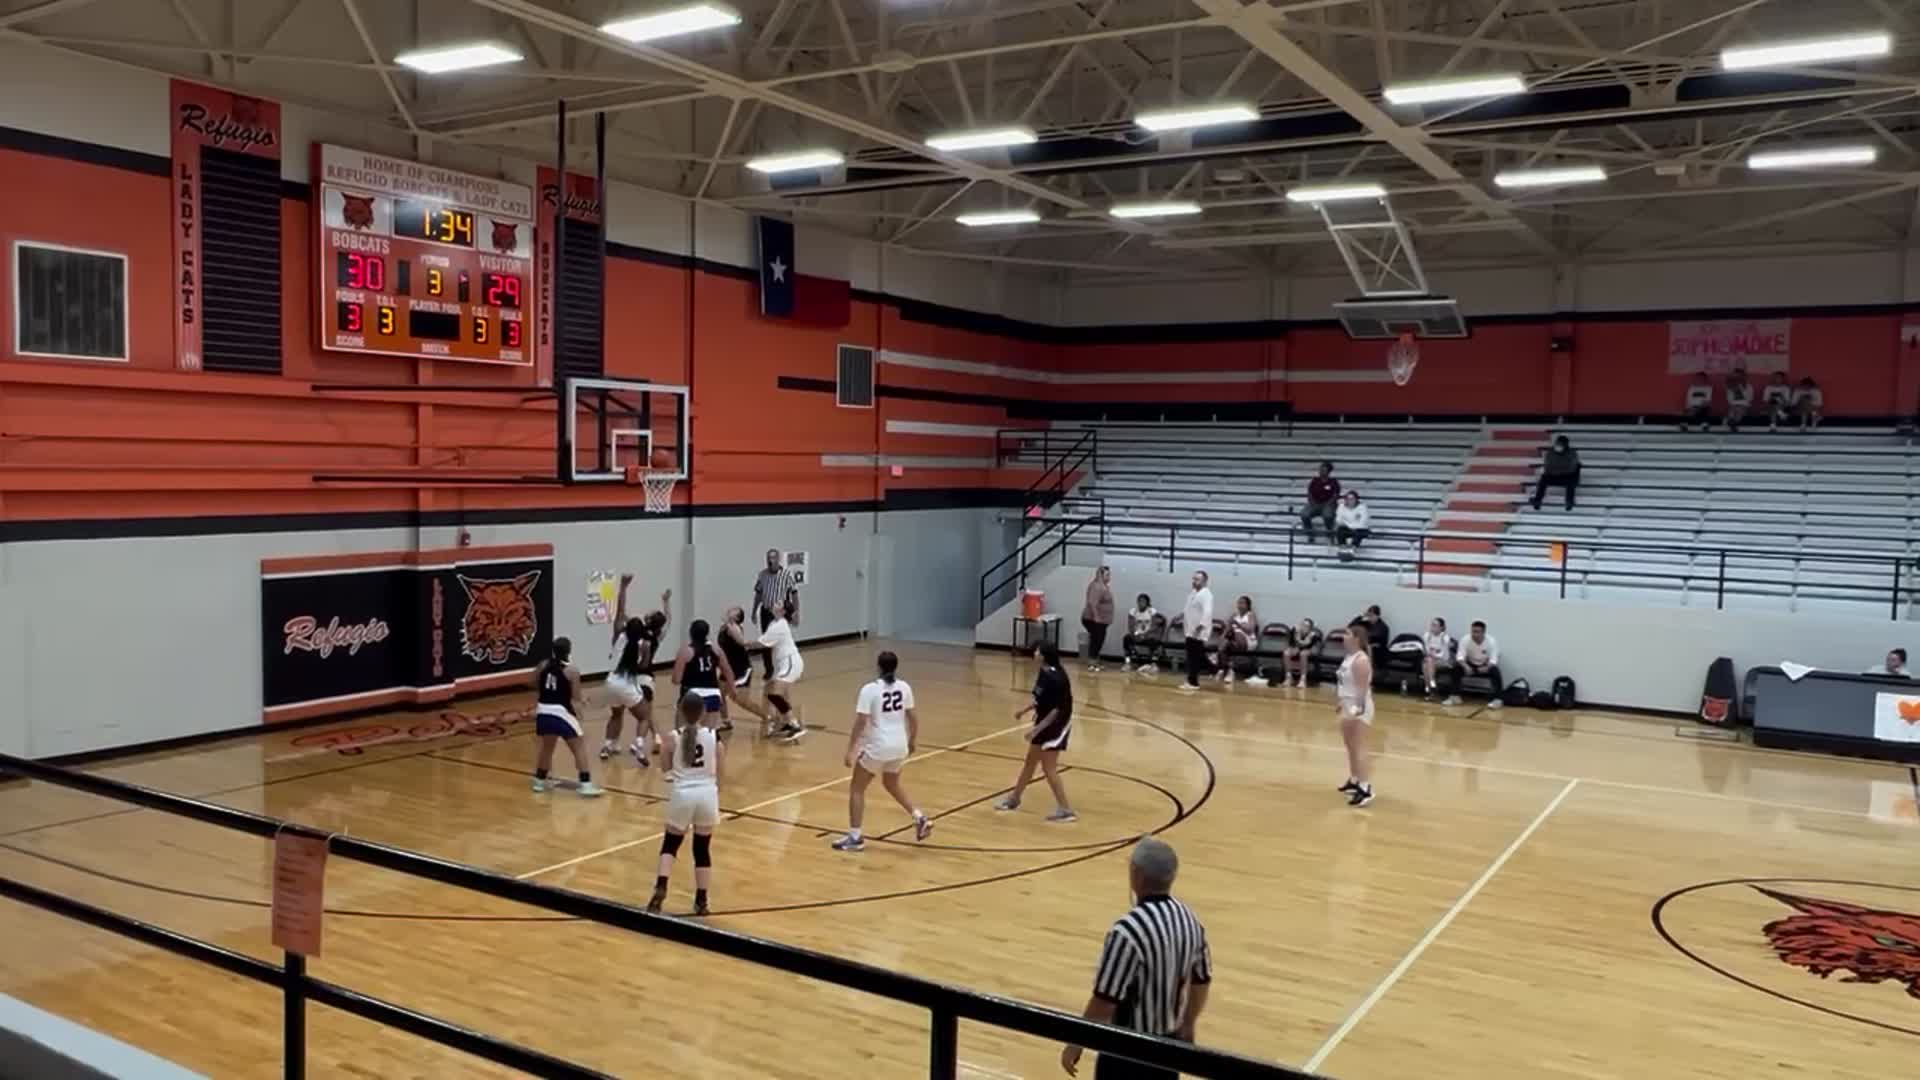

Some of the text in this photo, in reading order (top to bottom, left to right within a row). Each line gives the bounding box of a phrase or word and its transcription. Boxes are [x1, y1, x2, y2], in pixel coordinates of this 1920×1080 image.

[180, 103, 277, 151] Refugio
[327, 164, 388, 188] REFUGIO
[363, 156, 500, 194] HOME OF CHAMPIONS
[422, 207, 472, 243] 1:34
[181, 163, 194, 325] LADY CATS
[332, 231, 391, 255] BOBCATS
[347, 253, 384, 291] 30
[479, 254, 522, 273] VISITOR
[428, 269, 441, 295] 3
[487, 275, 520, 307] 29
[347, 304, 361, 331] 3
[380, 308, 393, 334] 3
[475, 318, 487, 343] 3
[508, 322, 520, 346] 3
[283, 615, 391, 660] Refugio
[881, 690, 904, 713] 22
